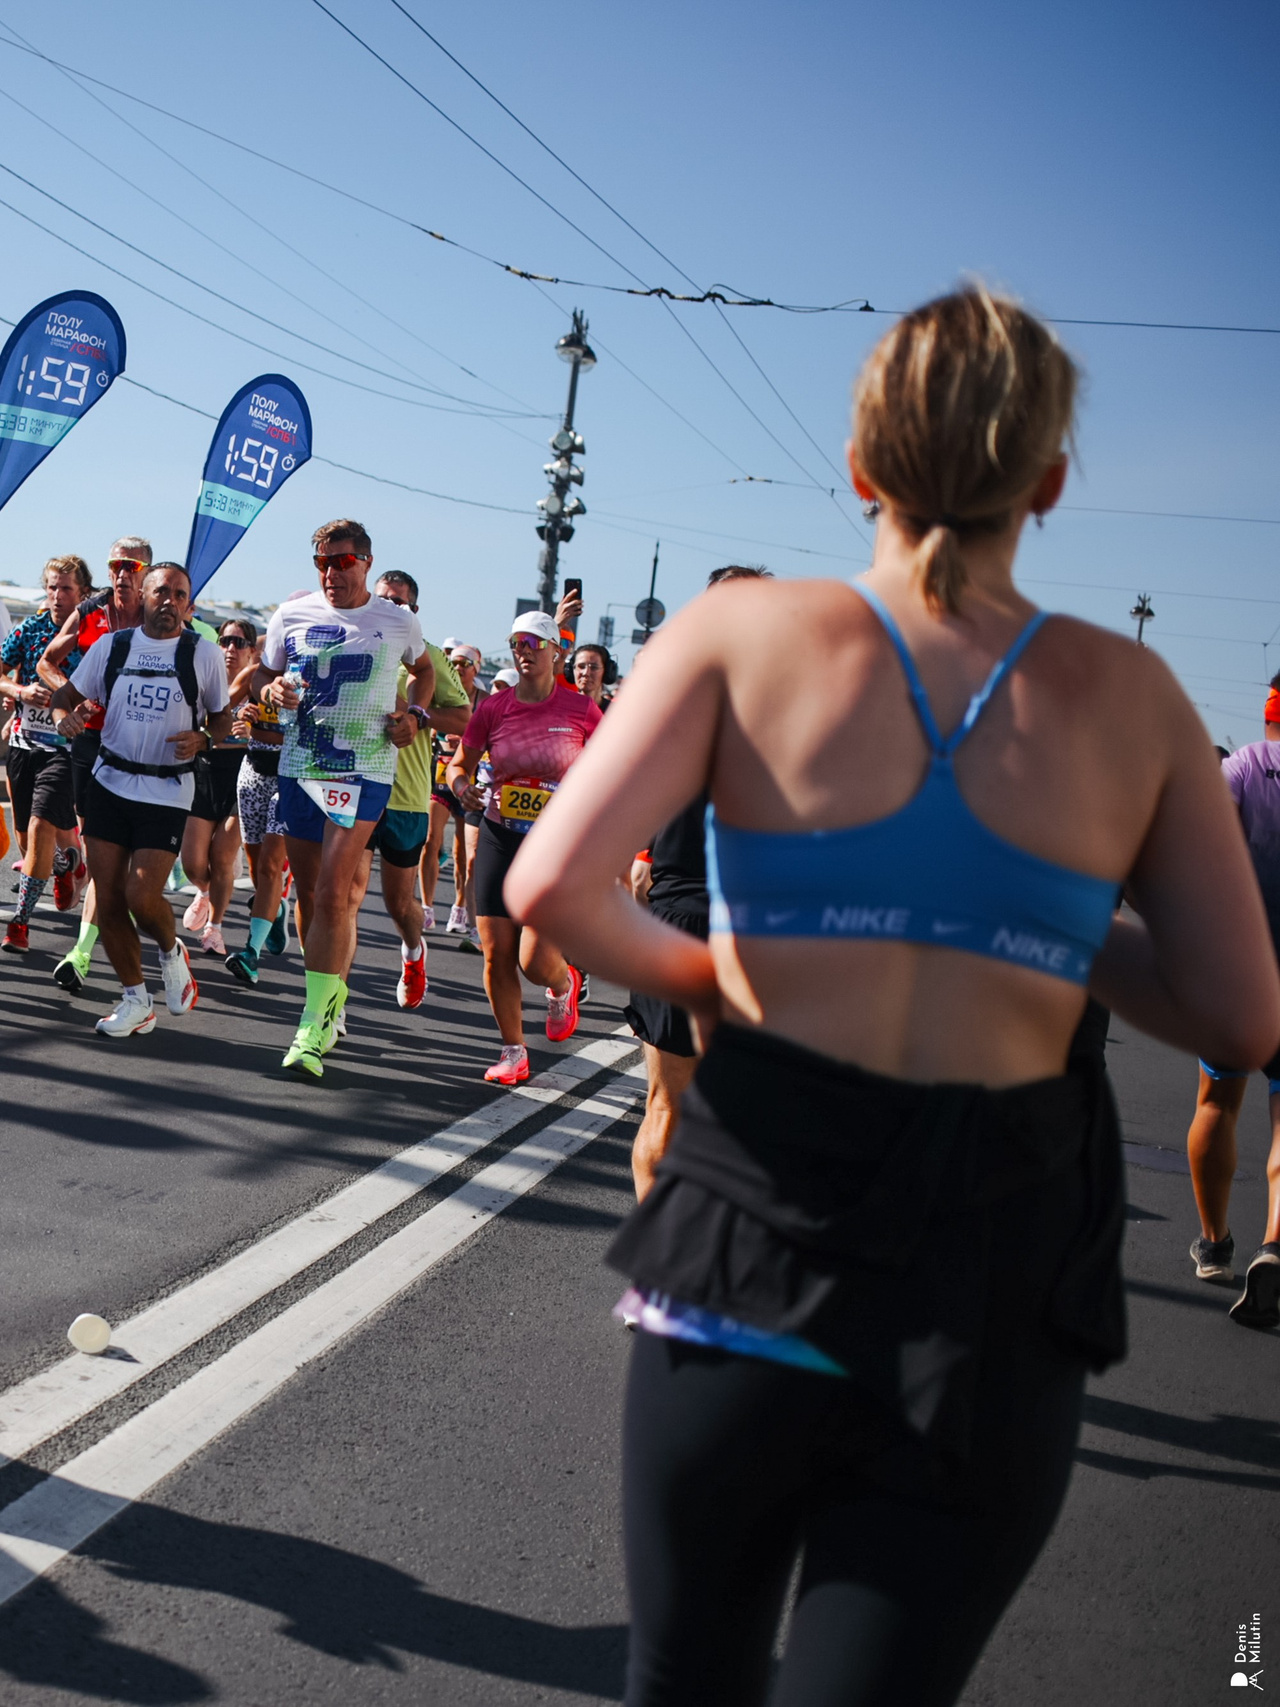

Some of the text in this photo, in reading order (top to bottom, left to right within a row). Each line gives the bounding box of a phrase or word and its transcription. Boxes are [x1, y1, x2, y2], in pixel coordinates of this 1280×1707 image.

[47, 312, 83, 329] ПОЛУ
[44, 324, 106, 350] МАРАФОН
[17, 354, 91, 406] 1:59
[251, 393, 279, 412] ПОЛУ
[248, 405, 298, 434] МАРАФОН
[29, 427, 43, 436] КМ
[225, 434, 279, 489] 1:59
[228, 507, 241, 517] КМ
[137, 661, 175, 670] МАРАФО
[127, 683, 171, 712] 1:59
[28, 709, 53, 725] 346
[126, 710, 145, 722] 5:38
[322, 789, 351, 808] 59
[508, 791, 550, 812] 286
[821, 906, 1073, 970] NIKE NIKE
